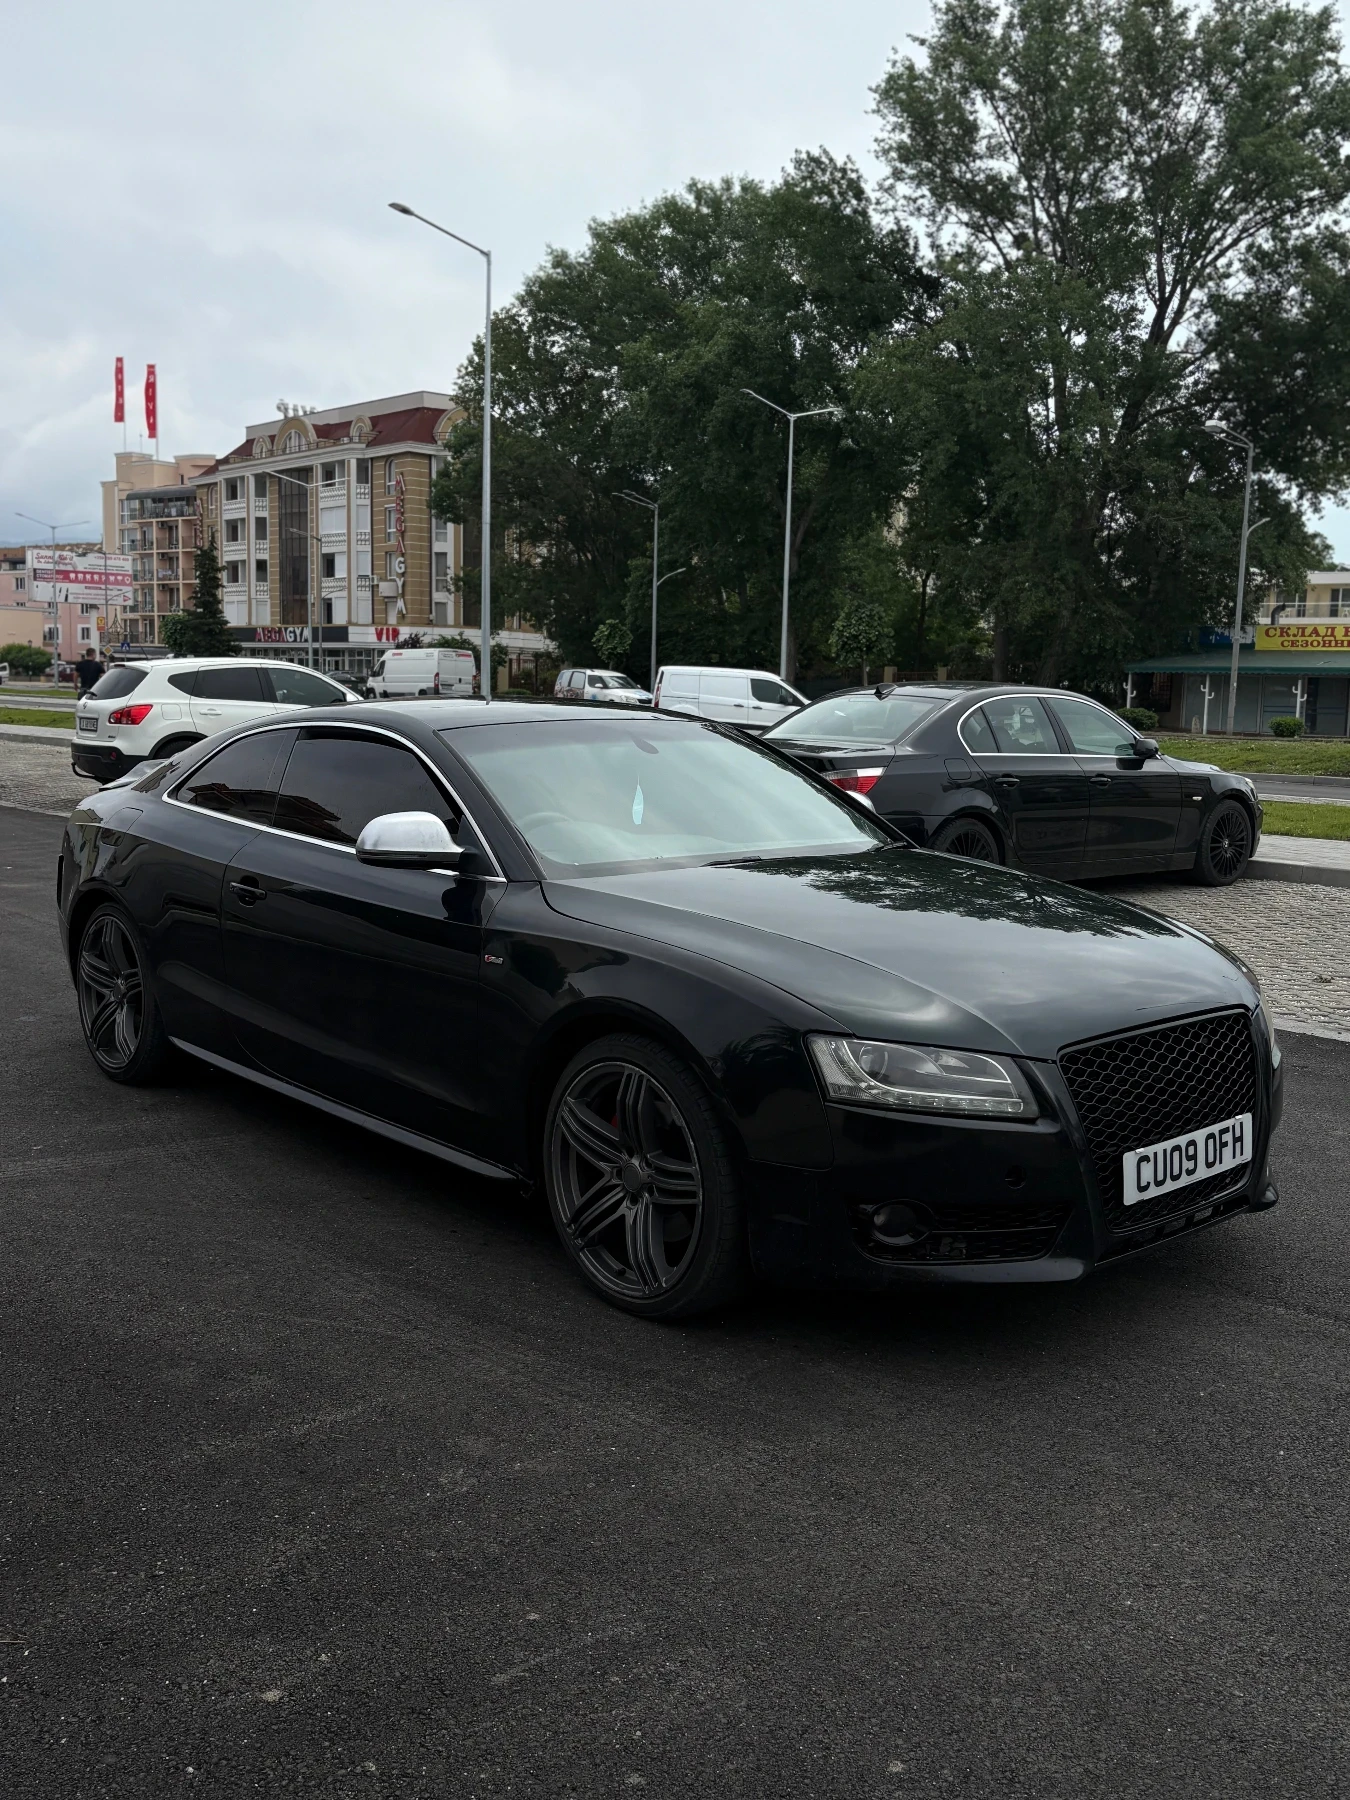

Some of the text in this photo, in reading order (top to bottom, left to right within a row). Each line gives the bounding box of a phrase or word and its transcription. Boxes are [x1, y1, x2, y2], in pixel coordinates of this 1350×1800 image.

[375, 627, 400, 642] VIP
[1264, 626, 1337, 641] СКЛАД
[1280, 639, 1350, 648] СЕЗОНН
[1136, 1121, 1244, 1193] CU09 OFH
